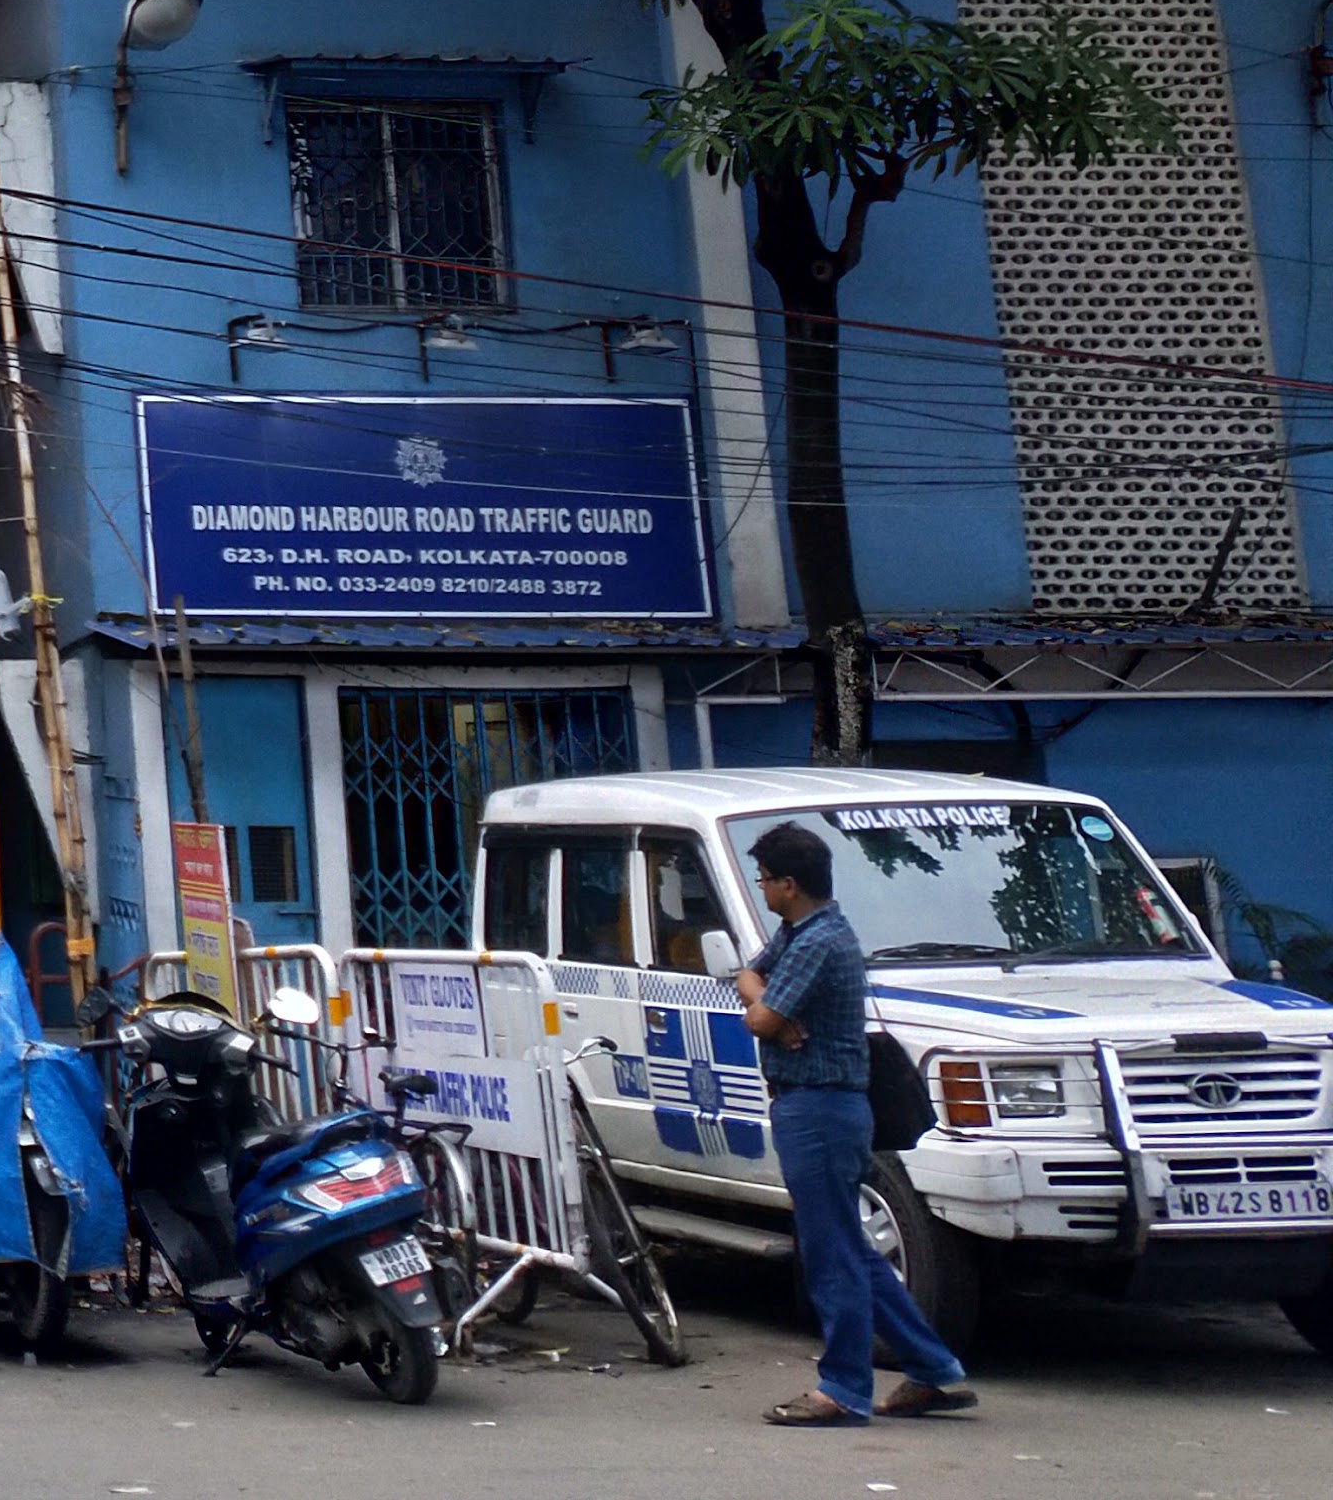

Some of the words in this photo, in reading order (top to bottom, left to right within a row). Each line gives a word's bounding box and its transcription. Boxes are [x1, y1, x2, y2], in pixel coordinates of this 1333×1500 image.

[192, 505, 295, 532] DIAMOND
[300, 506, 410, 532] HARBOUR
[415, 506, 475, 533] ROAD
[479, 507, 571, 533] TRAFFIC
[577, 508, 653, 534] GUARD
[222, 547, 274, 564] 623,
[280, 548, 330, 564] D.H.
[336, 548, 412, 564] ROAD,
[420, 549, 628, 566] KOLKATA-700008
[253, 576, 290, 592] PH.
[296, 576, 333, 592] NO.
[339, 577, 435, 593] 033-2409
[441, 577, 546, 594] 8210/2488
[551, 579, 603, 596] 3872
[836, 807, 935, 831] KOLKATA
[934, 806, 1010, 827] POLICE
[430, 975, 474, 1010] GLOVES
[470, 1074, 511, 1123] POLICE
[1180, 1191, 1210, 1216] WB
